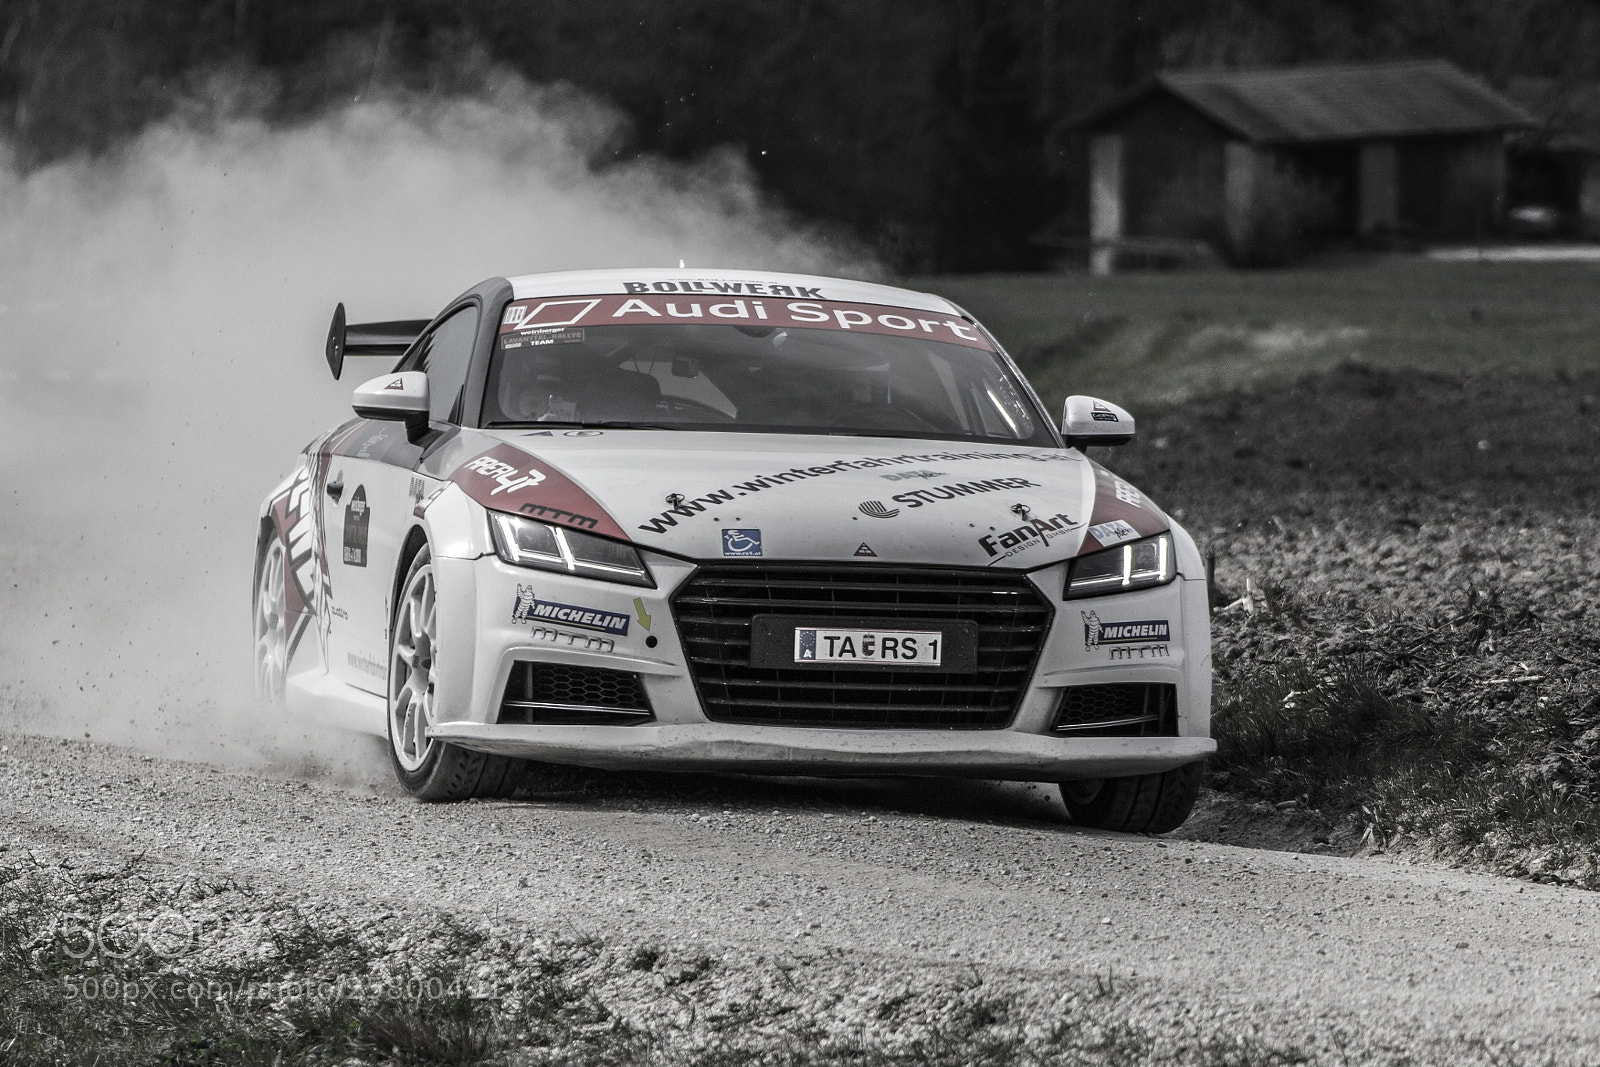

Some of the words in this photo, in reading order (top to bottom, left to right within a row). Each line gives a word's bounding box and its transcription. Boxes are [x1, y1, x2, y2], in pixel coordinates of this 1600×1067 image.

[611, 298, 768, 322] Audi
[786, 302, 978, 342] Sport
[892, 477, 1041, 508] STUMMER
[978, 513, 1078, 557] FanArt
[1093, 521, 1126, 539] DATA
[1005, 539, 1041, 557] DESIGN
[533, 604, 628, 630] MICHELIN
[1104, 624, 1167, 638] MICHELIN
[803, 649, 812, 658] A
[823, 636, 856, 657] TA
[881, 637, 917, 660] RS
[928, 639, 937, 660] 1
